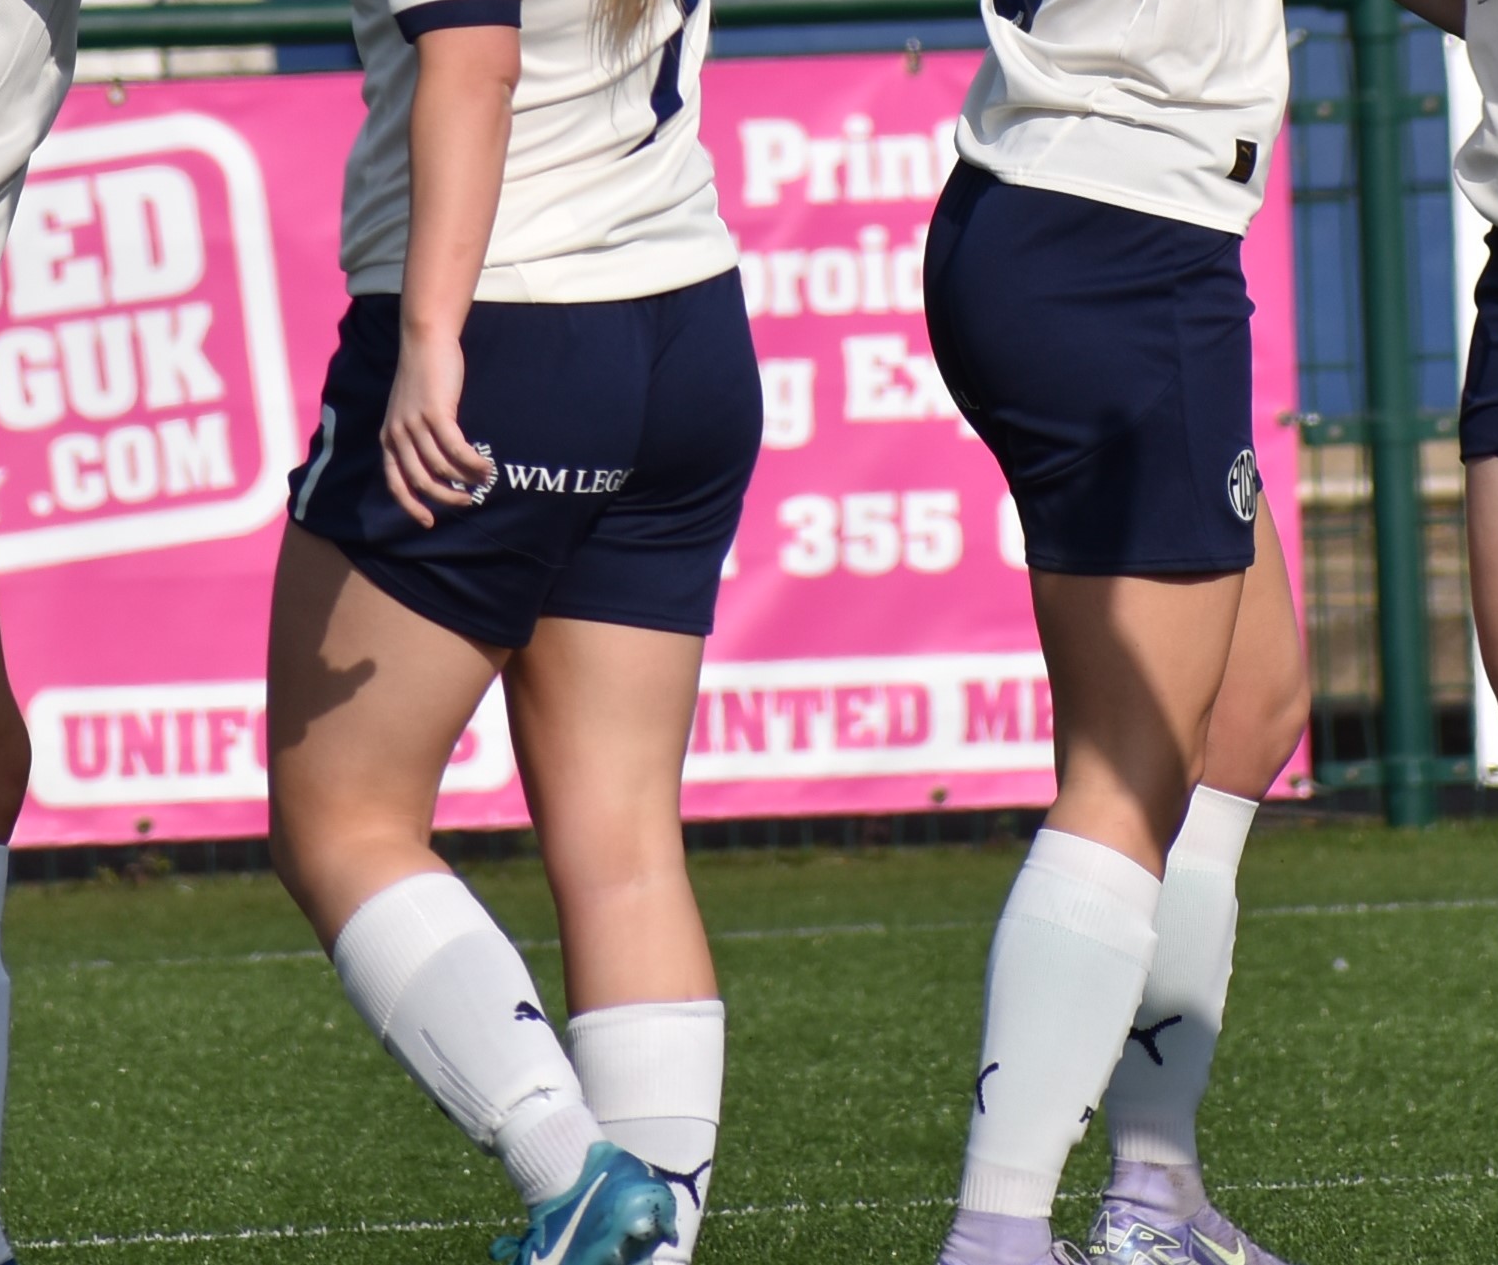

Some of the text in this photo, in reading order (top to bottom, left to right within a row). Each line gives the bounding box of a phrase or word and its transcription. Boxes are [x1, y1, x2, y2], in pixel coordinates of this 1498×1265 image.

[27, 412, 236, 514] .COM
[504, 463, 569, 494] WM
[777, 491, 964, 579] 355
